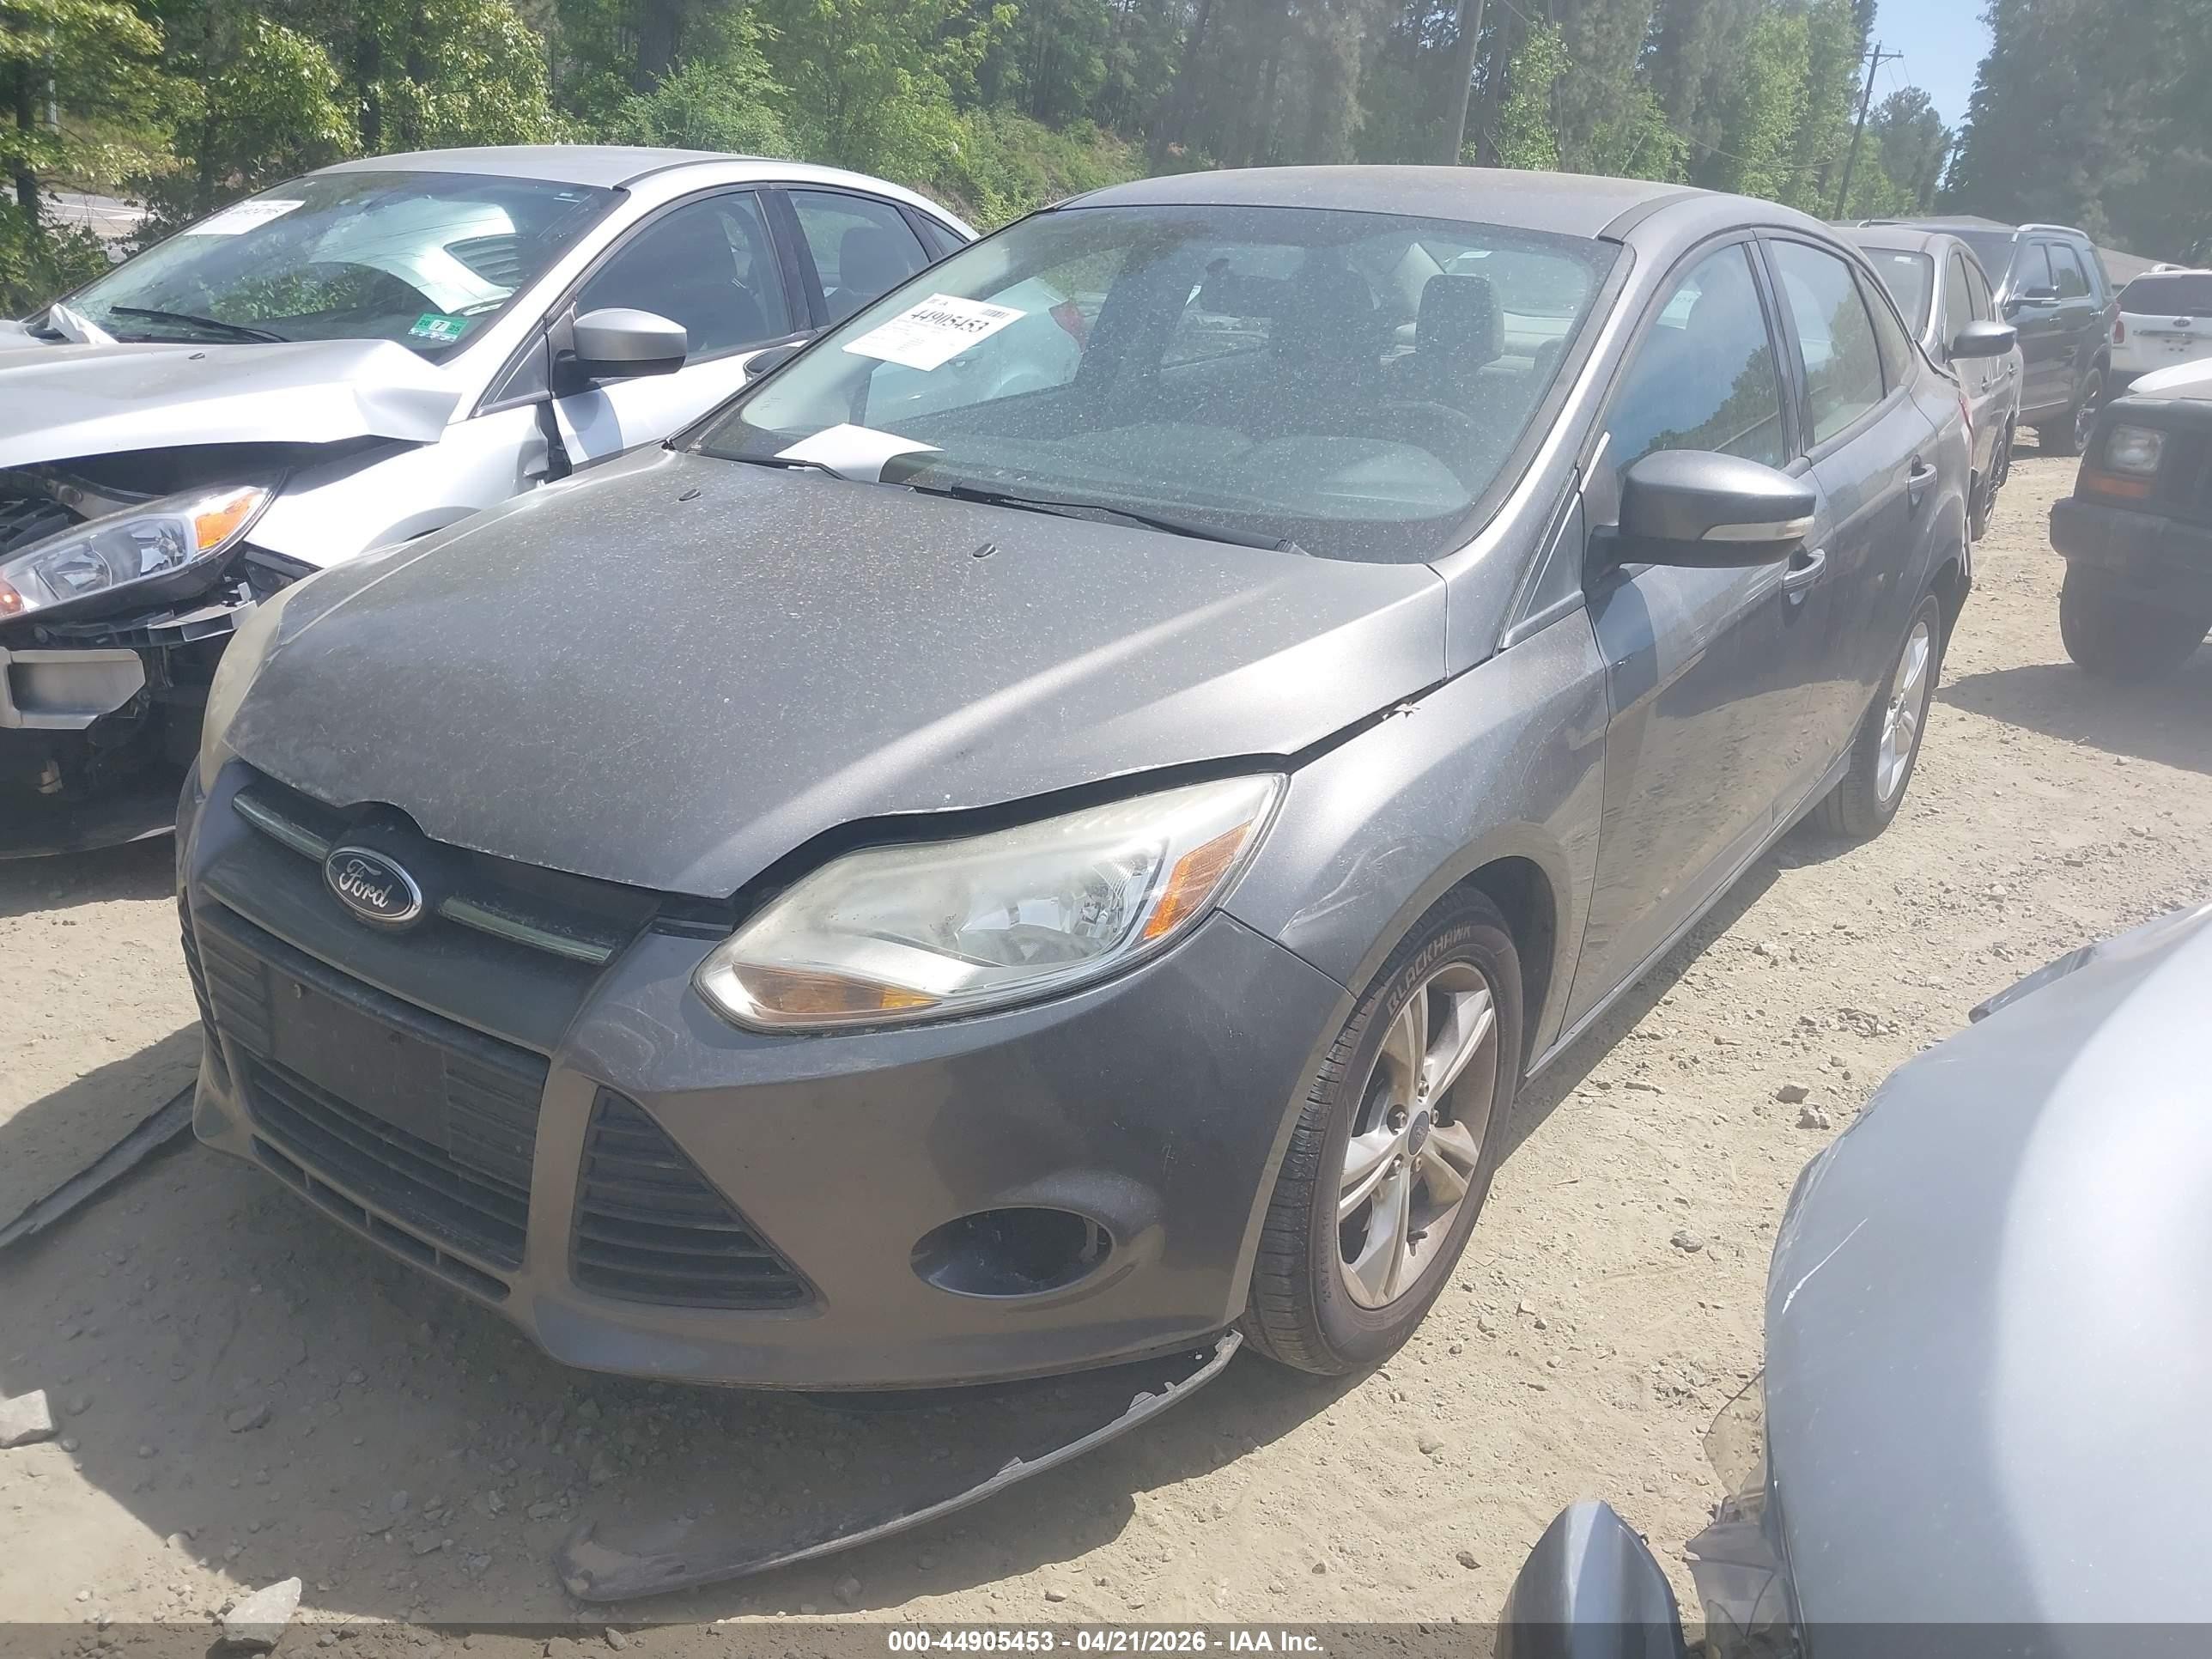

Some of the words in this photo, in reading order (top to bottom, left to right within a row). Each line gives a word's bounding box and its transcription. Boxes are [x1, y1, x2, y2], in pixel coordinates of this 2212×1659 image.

[434, 321, 445, 330] 7
[910, 308, 990, 332] 44905453
[339, 859, 392, 908] Ford
[1386, 921, 1471, 1017] BLACKHAWK
